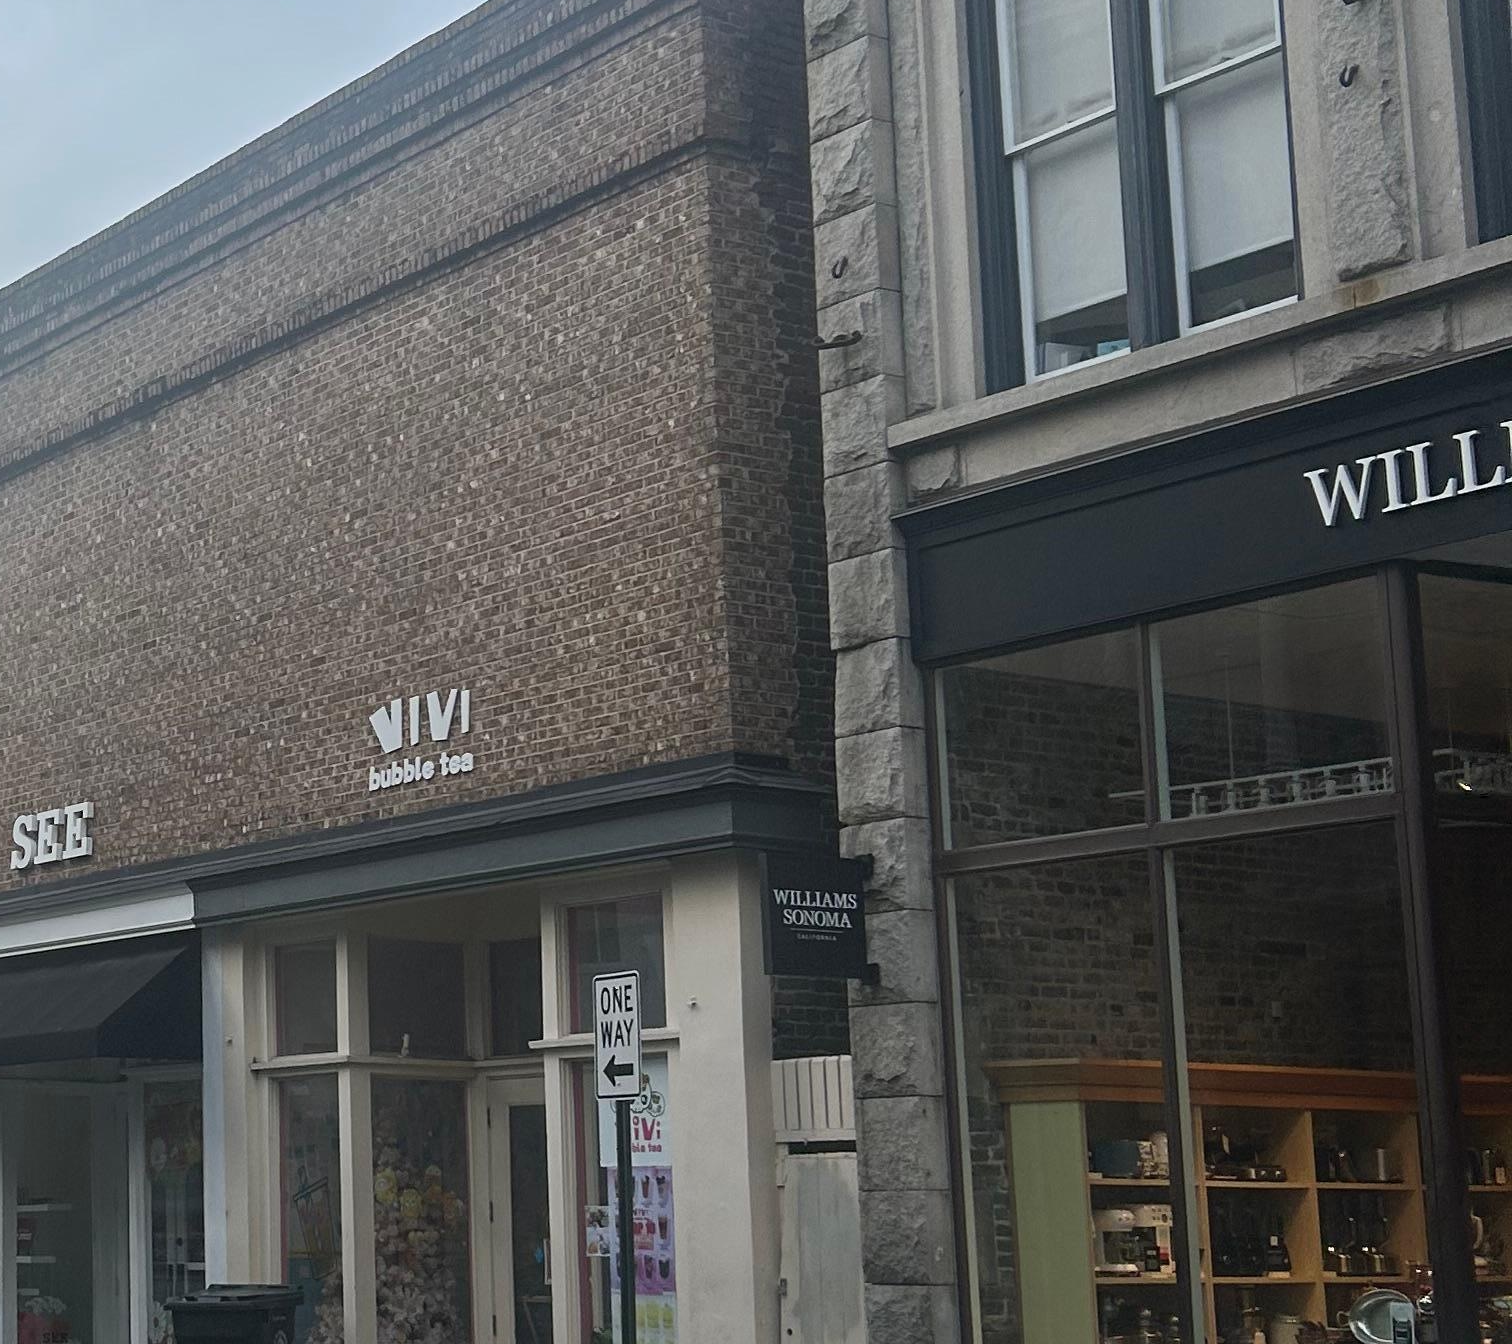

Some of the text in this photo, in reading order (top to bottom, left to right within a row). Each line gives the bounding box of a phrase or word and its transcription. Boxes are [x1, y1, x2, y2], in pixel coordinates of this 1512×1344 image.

[369, 688, 471, 754] VIVI
[368, 752, 474, 792] bubble tea
[10, 801, 94, 870] SEE
[773, 888, 857, 910] WILLIAMS
[783, 908, 853, 928] SONOMA
[600, 984, 634, 1015] ONE
[600, 1018, 635, 1049] WAY
[632, 1116, 662, 1141] iVi
